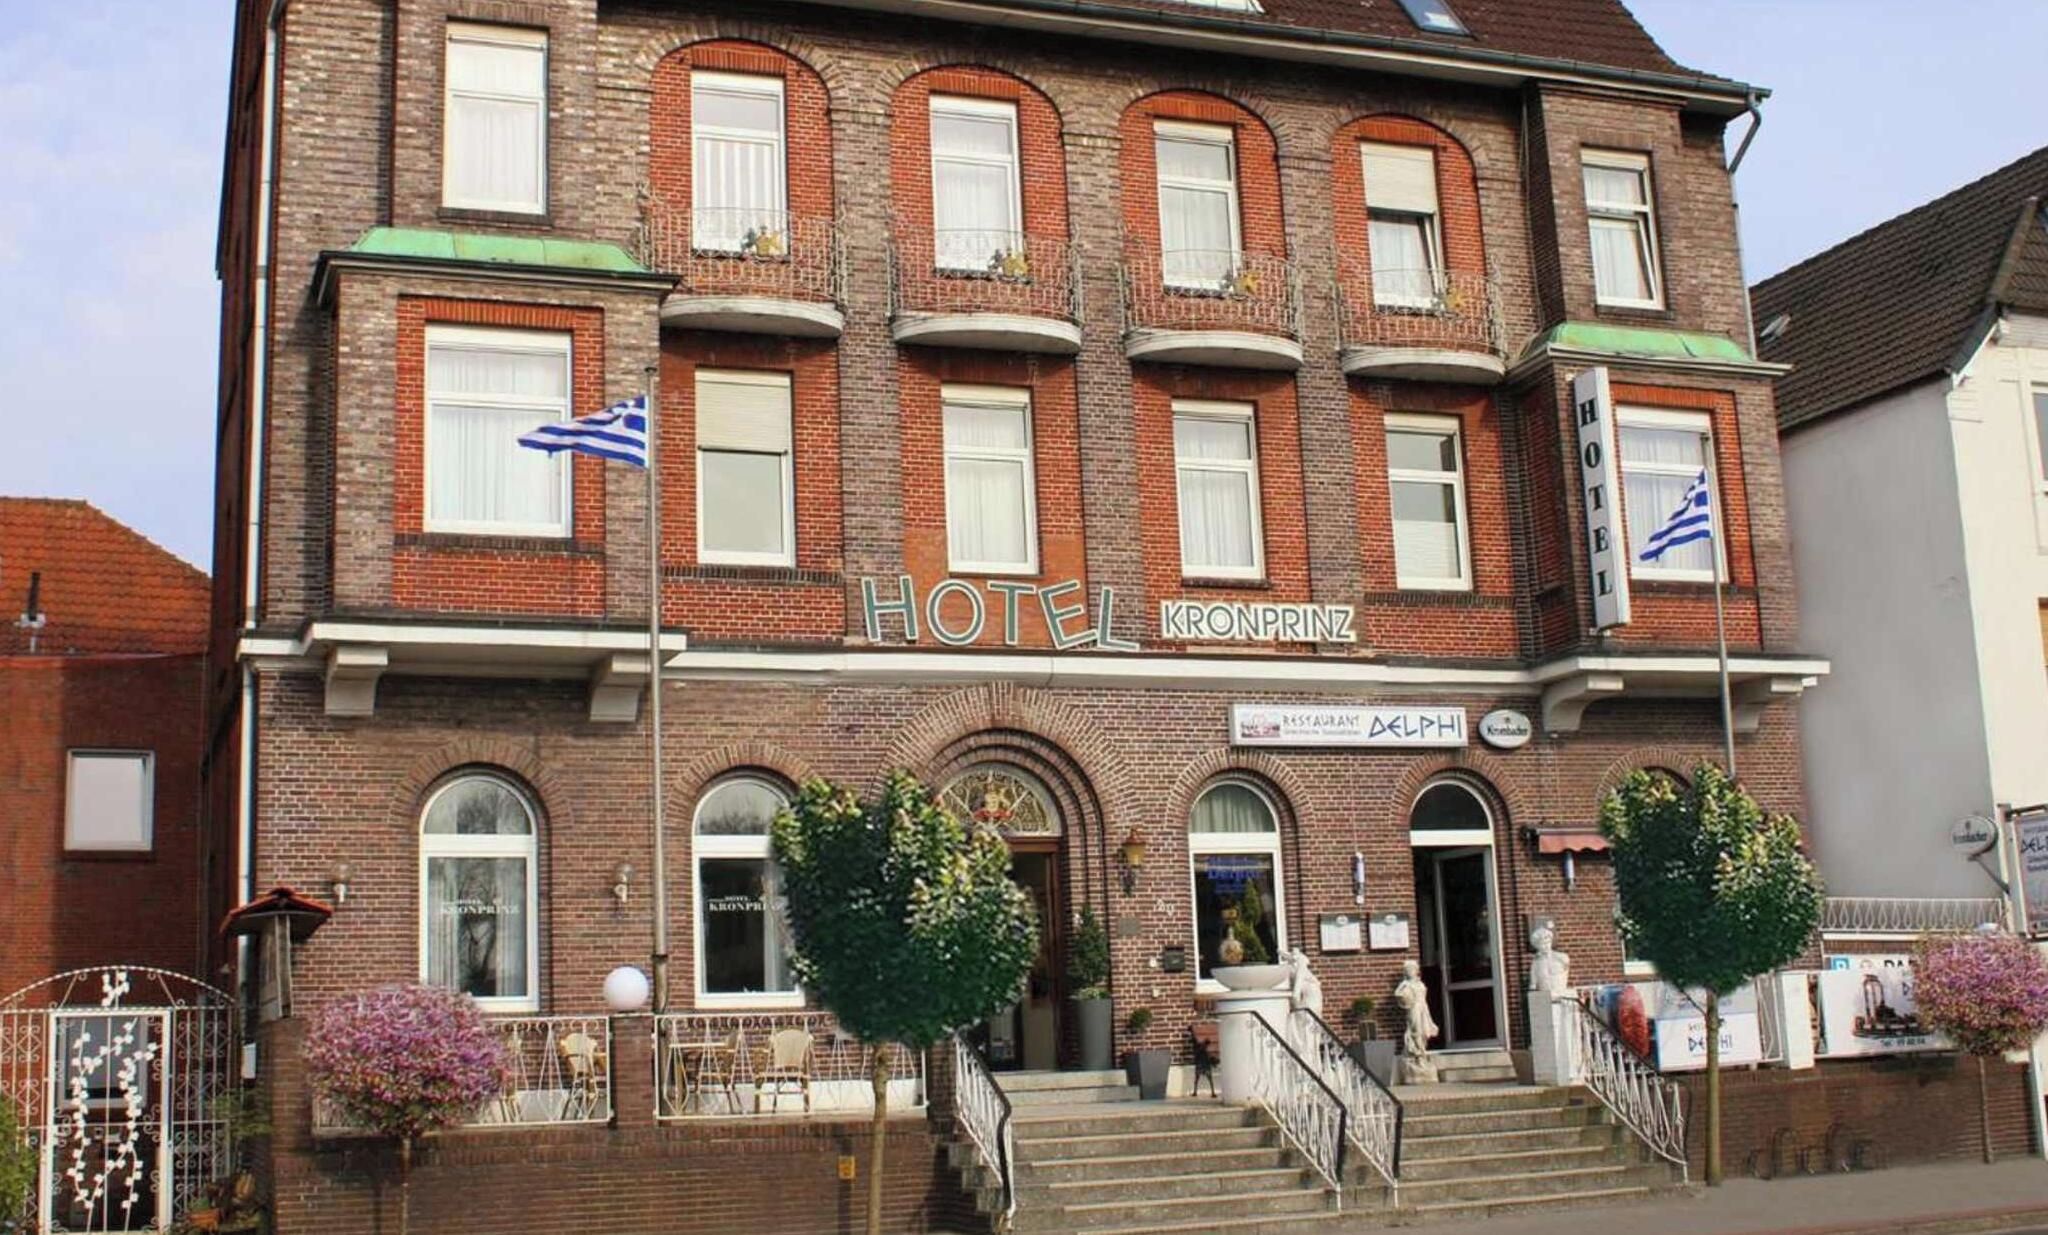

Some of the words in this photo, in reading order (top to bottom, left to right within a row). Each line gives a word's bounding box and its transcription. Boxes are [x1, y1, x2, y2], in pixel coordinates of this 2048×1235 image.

[1578, 398, 1613, 597] HOTEL
[861, 575, 1140, 650] HOTEL
[1160, 600, 1358, 643] KRONPRINZ
[1282, 714, 1360, 727] RESTAURANT
[1368, 714, 1462, 739] DELPHI
